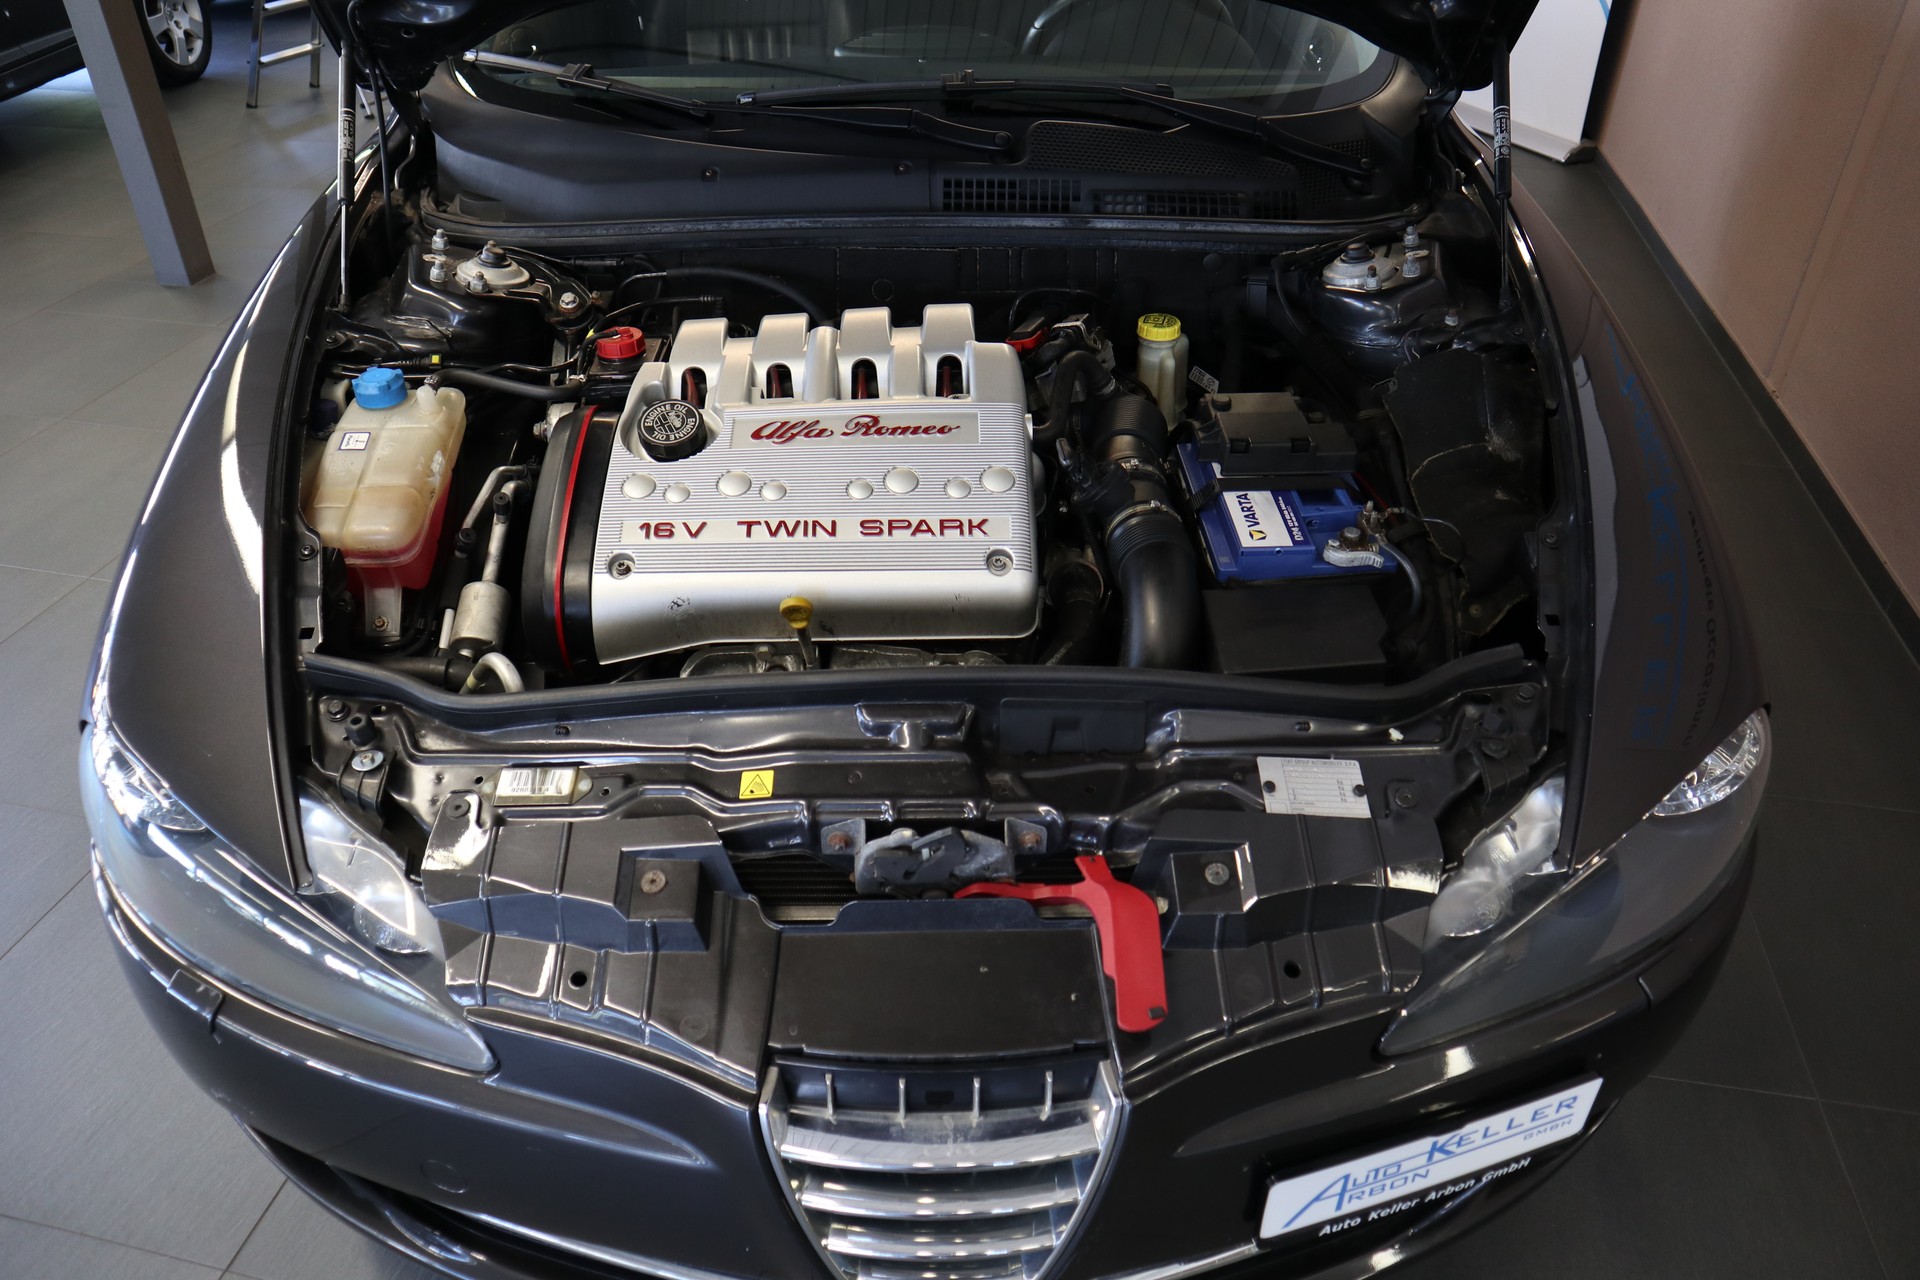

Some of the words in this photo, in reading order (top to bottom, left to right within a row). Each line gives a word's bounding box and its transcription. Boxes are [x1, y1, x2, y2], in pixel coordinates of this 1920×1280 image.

[644, 404, 671, 427] ENGINE
[673, 404, 688, 414] OIL
[669, 418, 696, 440] ENGINE
[652, 431, 667, 441] OIL
[750, 420, 833, 445] Alfa
[840, 414, 961, 437] Romeo
[1236, 493, 1261, 528] VARTA
[737, 519, 837, 539] TWIN
[859, 518, 990, 538] SPARK
[1426, 1096, 1579, 1163] KELLER
[1318, 1217, 1361, 1237] Auto
[1368, 1197, 1420, 1222] Keller
[1425, 1178, 1476, 1203] Arbon
[1481, 1157, 1531, 1183] GmbH
